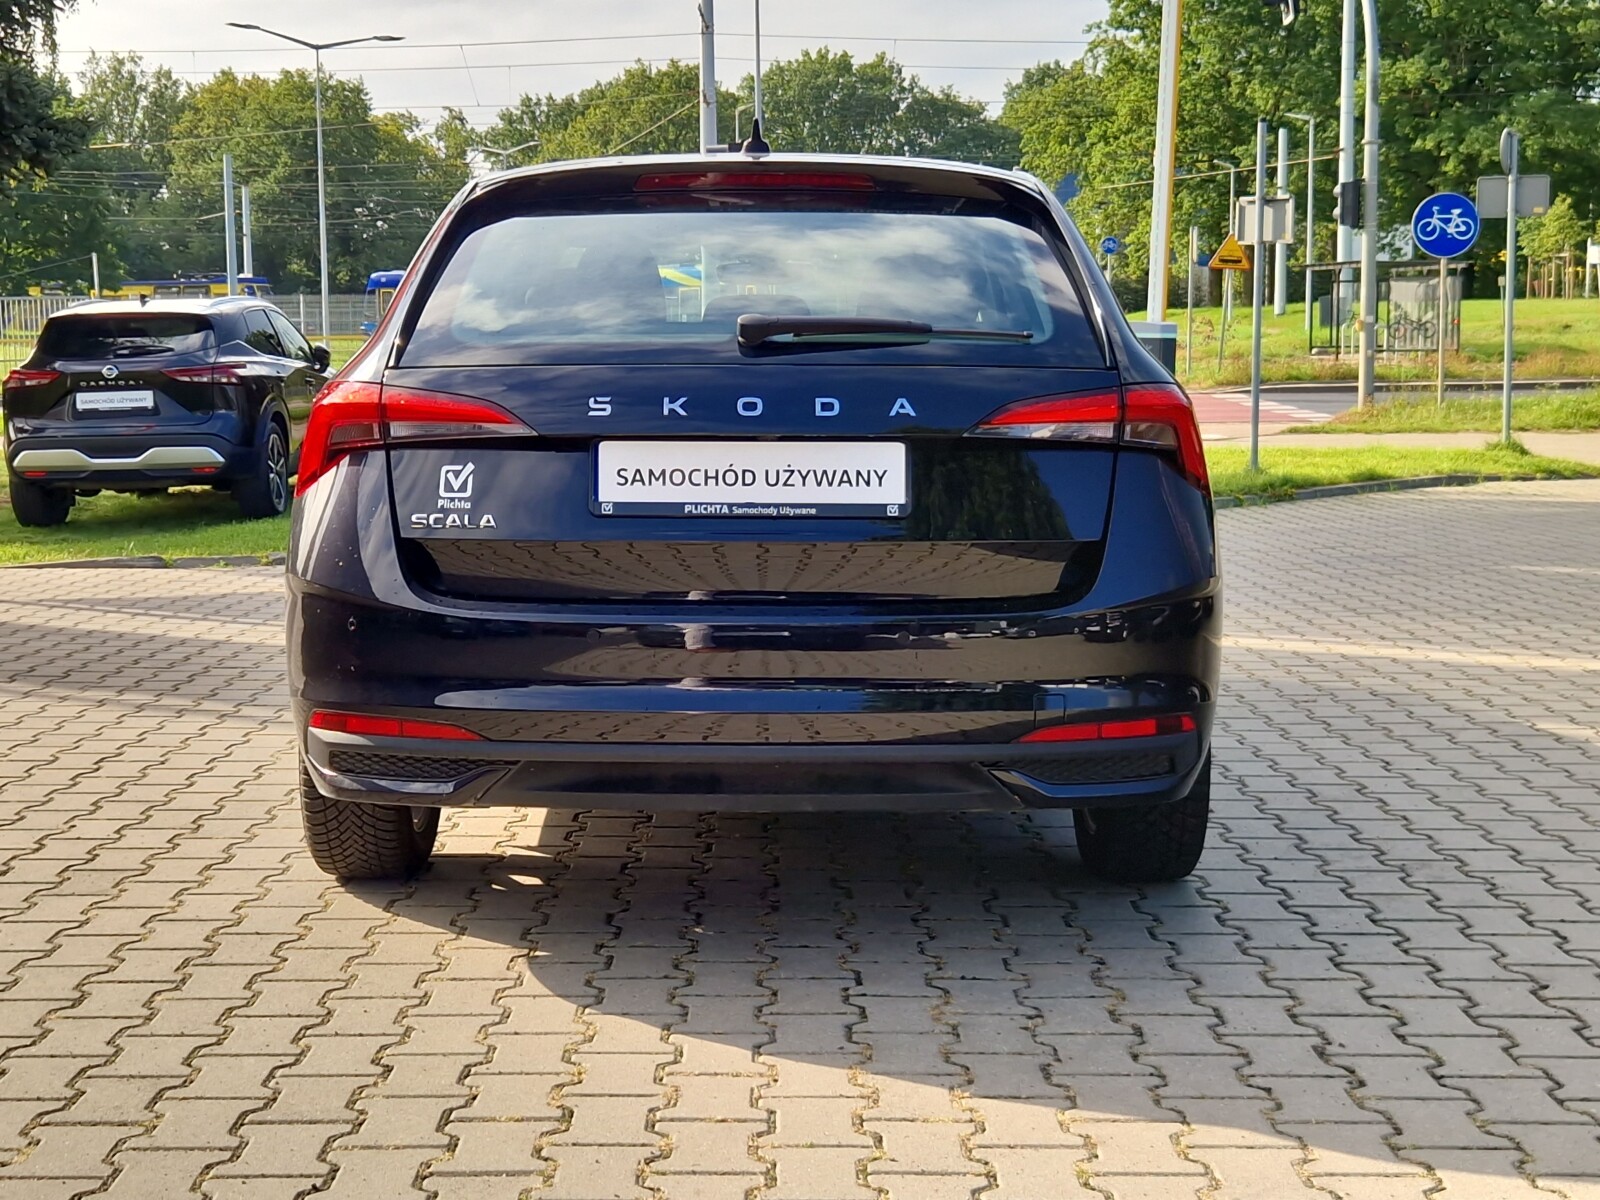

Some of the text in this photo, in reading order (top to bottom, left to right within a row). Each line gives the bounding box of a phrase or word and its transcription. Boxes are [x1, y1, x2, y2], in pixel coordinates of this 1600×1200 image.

[587, 396, 916, 417] SKODA
[616, 463, 889, 488] SAMOCHÓD UŻYWANY
[437, 498, 471, 509] Plichta
[684, 504, 817, 516] PLICHTA Samochody Używane
[410, 513, 497, 529] SCALA
